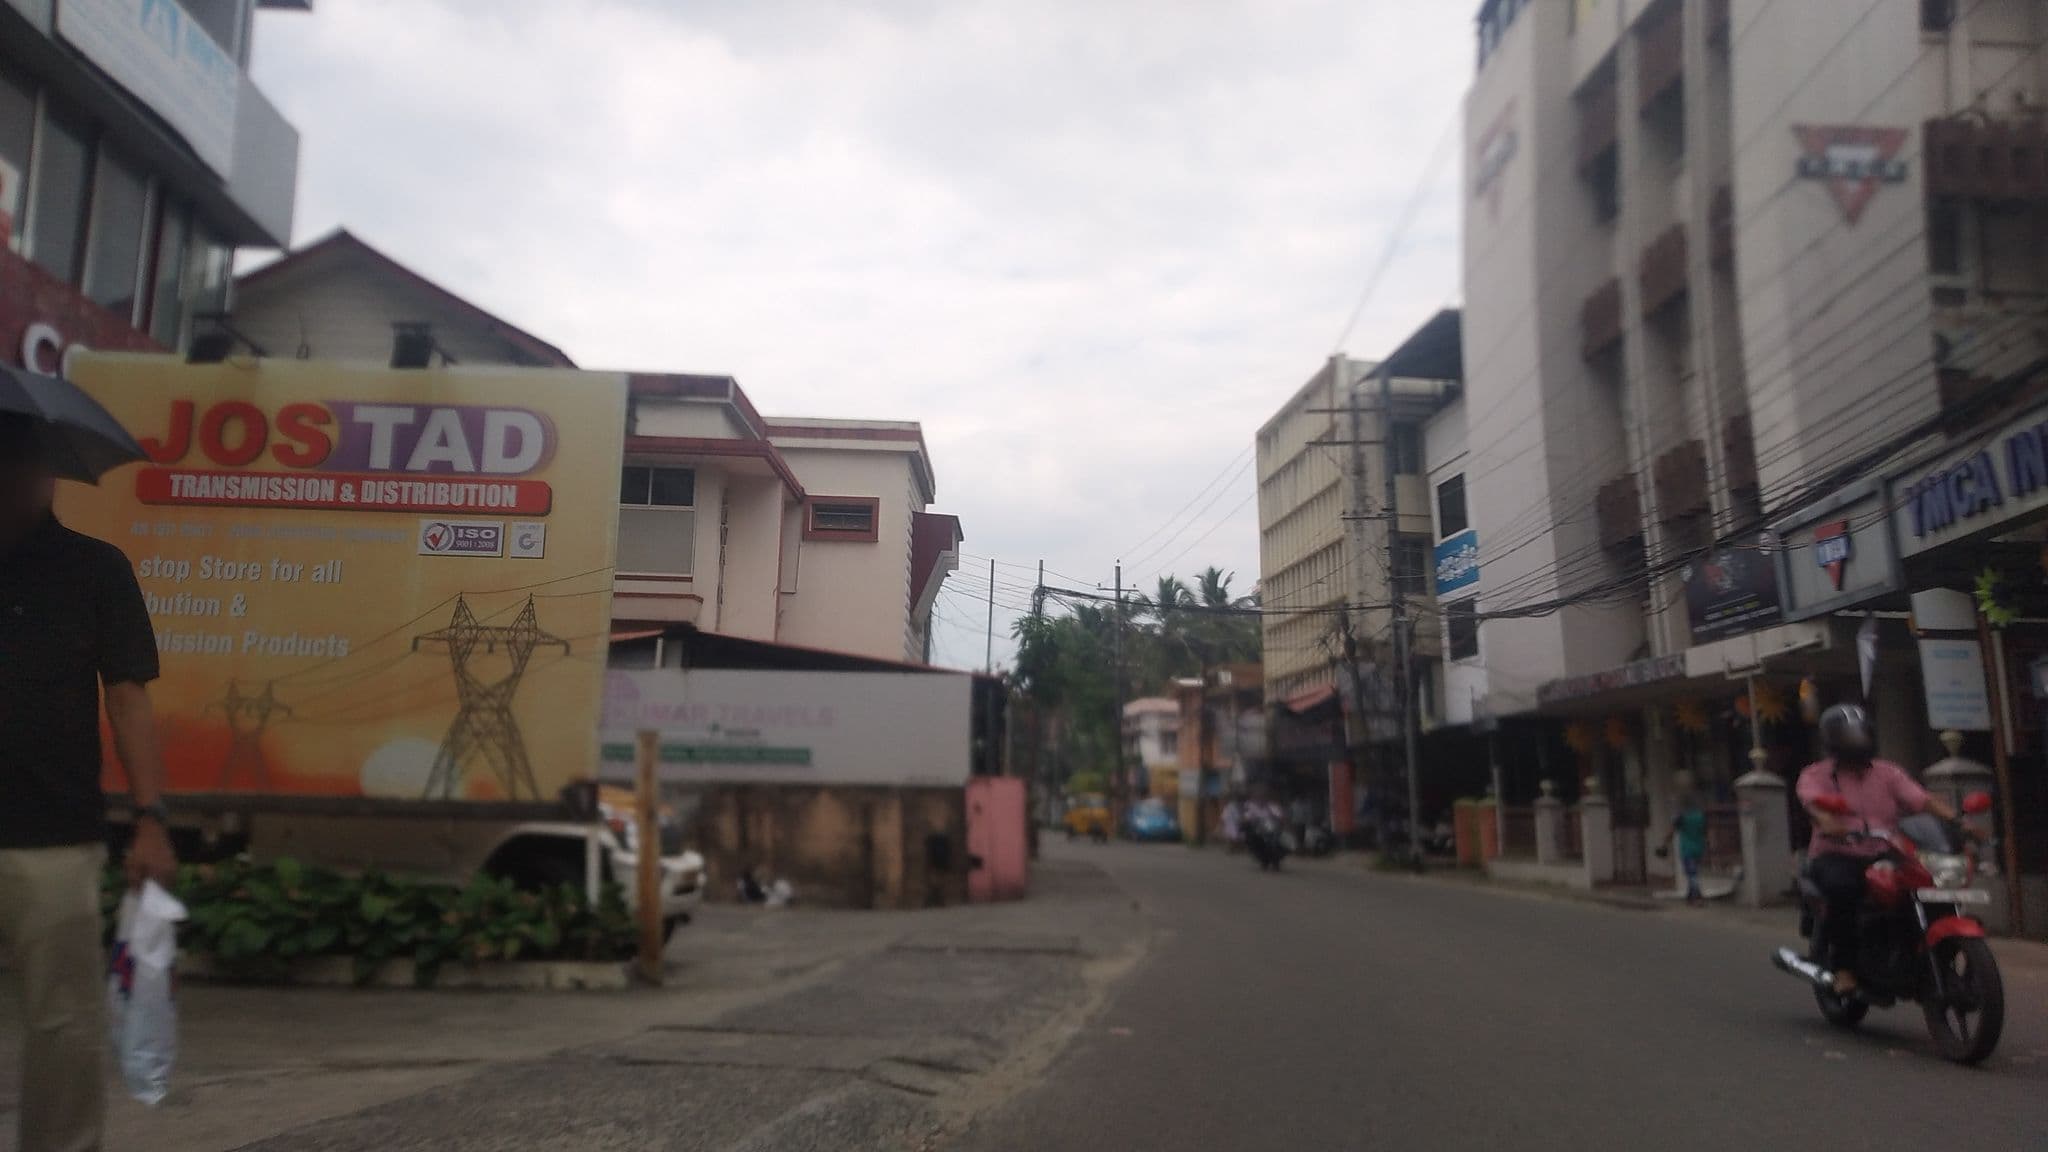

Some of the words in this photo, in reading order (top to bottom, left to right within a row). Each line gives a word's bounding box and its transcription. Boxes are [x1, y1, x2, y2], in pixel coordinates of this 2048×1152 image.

[139, 399, 333, 468] JOS
[353, 405, 545, 474] TAD
[169, 474, 334, 502] TRANSMISSION
[340, 482, 355, 502] &
[361, 482, 517, 508] DISTRIBUTION
[1903, 452, 2001, 537] YMCA
[457, 528, 496, 539] ISO
[139, 554, 191, 583] stop
[199, 554, 262, 582] Store
[270, 557, 304, 583] for
[311, 560, 343, 583] all
[229, 592, 248, 617] &
[242, 632, 350, 657] Products
